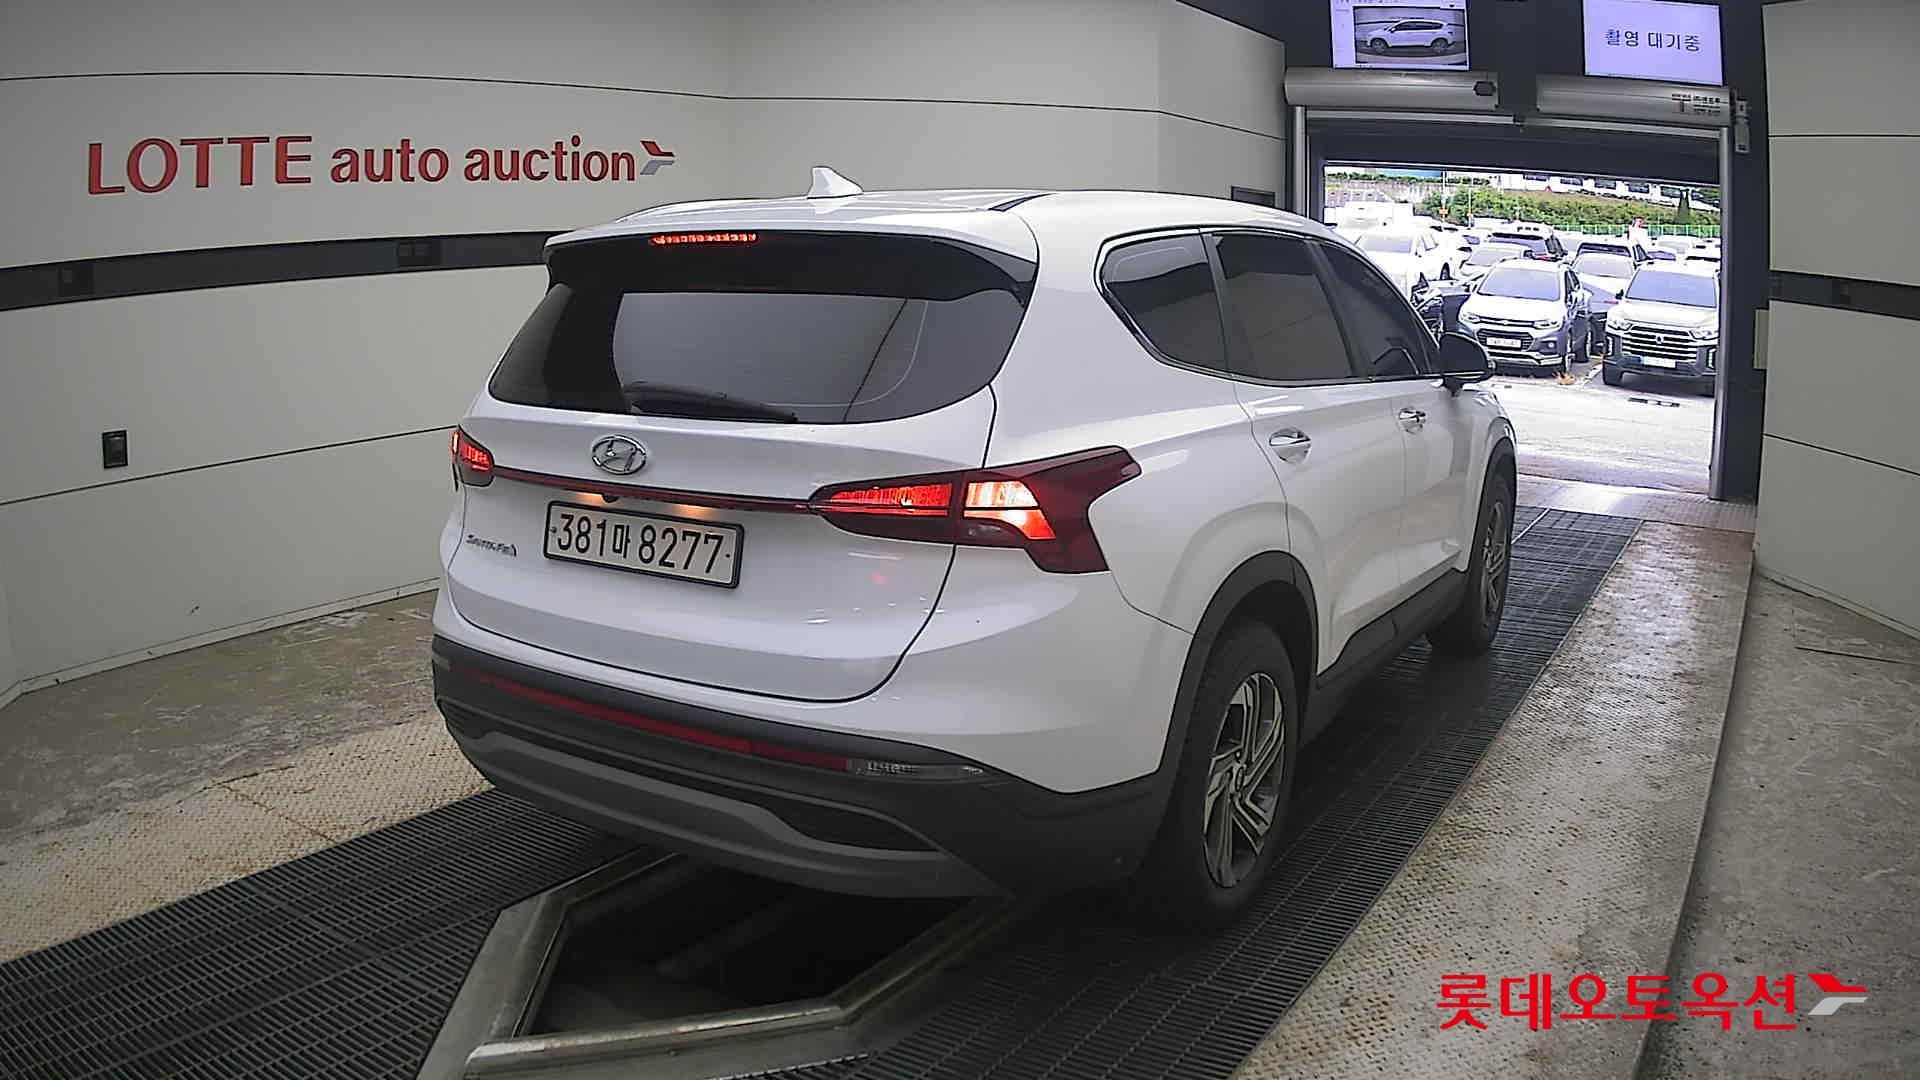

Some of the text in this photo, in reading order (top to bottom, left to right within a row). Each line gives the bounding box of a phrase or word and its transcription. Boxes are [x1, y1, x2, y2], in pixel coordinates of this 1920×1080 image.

[1648, 32, 1700, 51] 대기중
[88, 135, 636, 195] LOTTE auto auction
[557, 513, 631, 559] 381마
[638, 524, 724, 573] 8277
